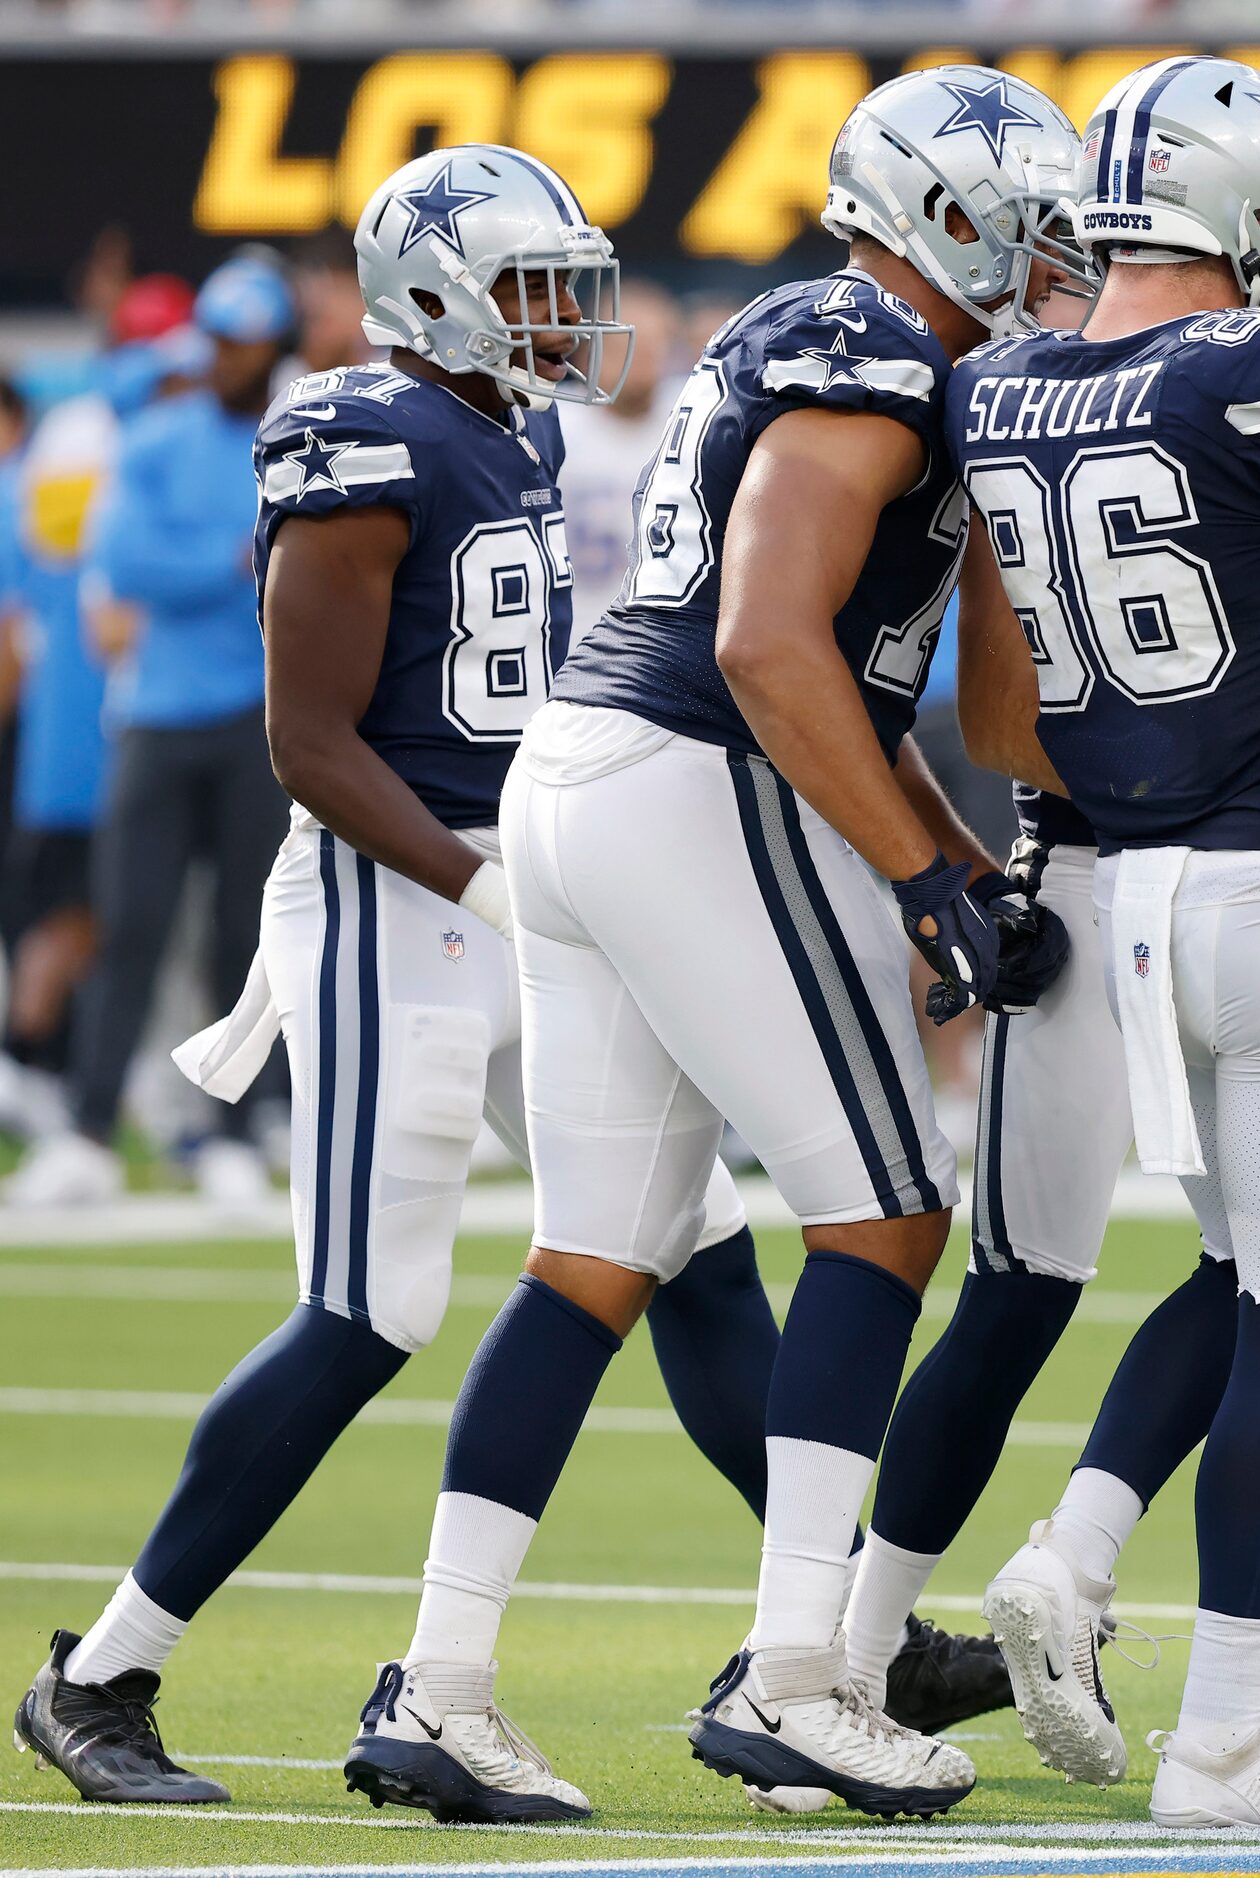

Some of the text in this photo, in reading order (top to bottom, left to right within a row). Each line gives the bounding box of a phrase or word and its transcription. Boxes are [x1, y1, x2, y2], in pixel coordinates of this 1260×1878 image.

[193, 49, 672, 236] LOS
[1151, 158, 1168, 171] NFL
[1084, 212, 1152, 231] COWBOYS
[966, 362, 1165, 443] SCHULTZ
[442, 510, 575, 743] 8
[964, 440, 1237, 714] 86
